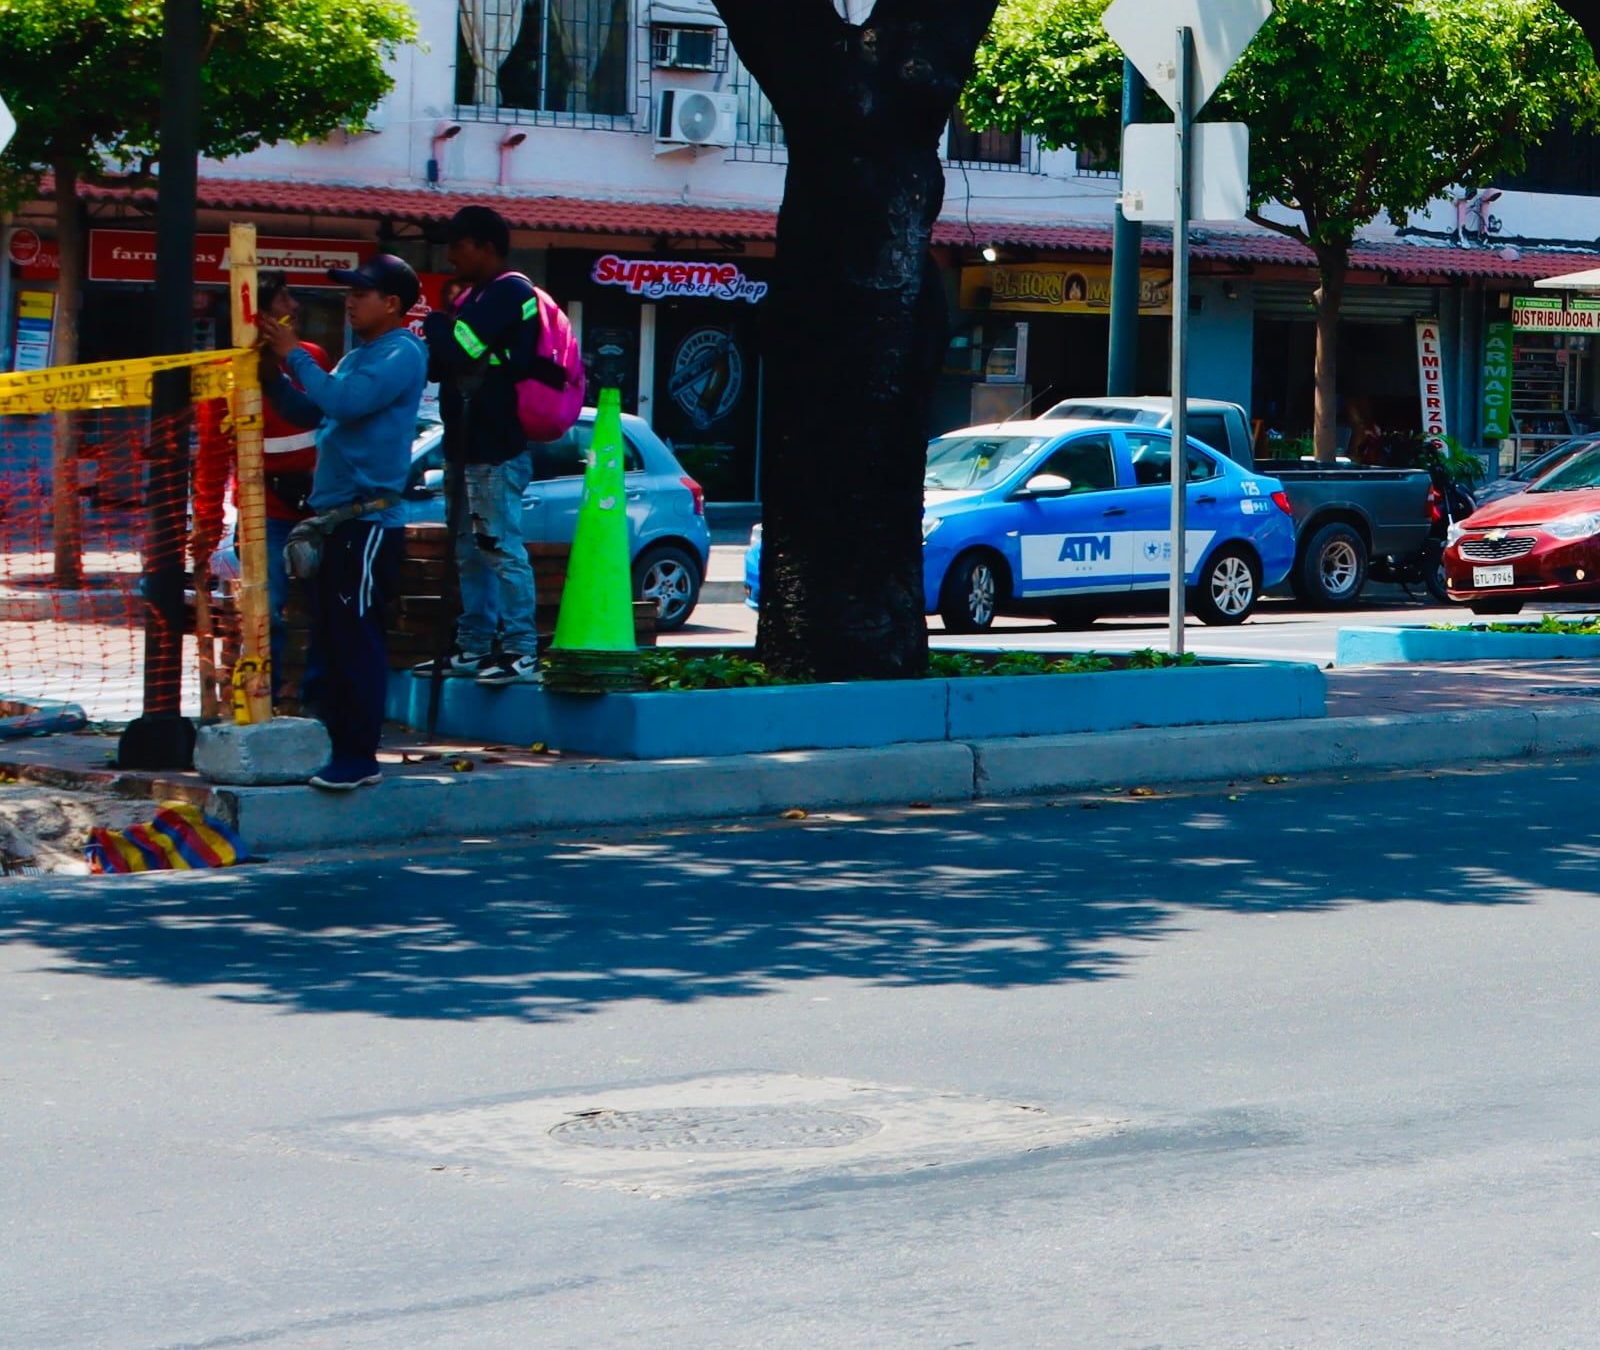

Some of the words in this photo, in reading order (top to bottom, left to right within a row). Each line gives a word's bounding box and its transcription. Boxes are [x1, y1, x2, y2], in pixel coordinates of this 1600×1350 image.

[597, 257, 736, 291] Supreme
[719, 276, 767, 300] Shop
[1513, 310, 1593, 328] DISTRIBUIDORA
[1422, 328, 1443, 450] ALMUERZOS
[1483, 322, 1507, 435] FARMACIA
[1058, 535, 1111, 562] ATM
